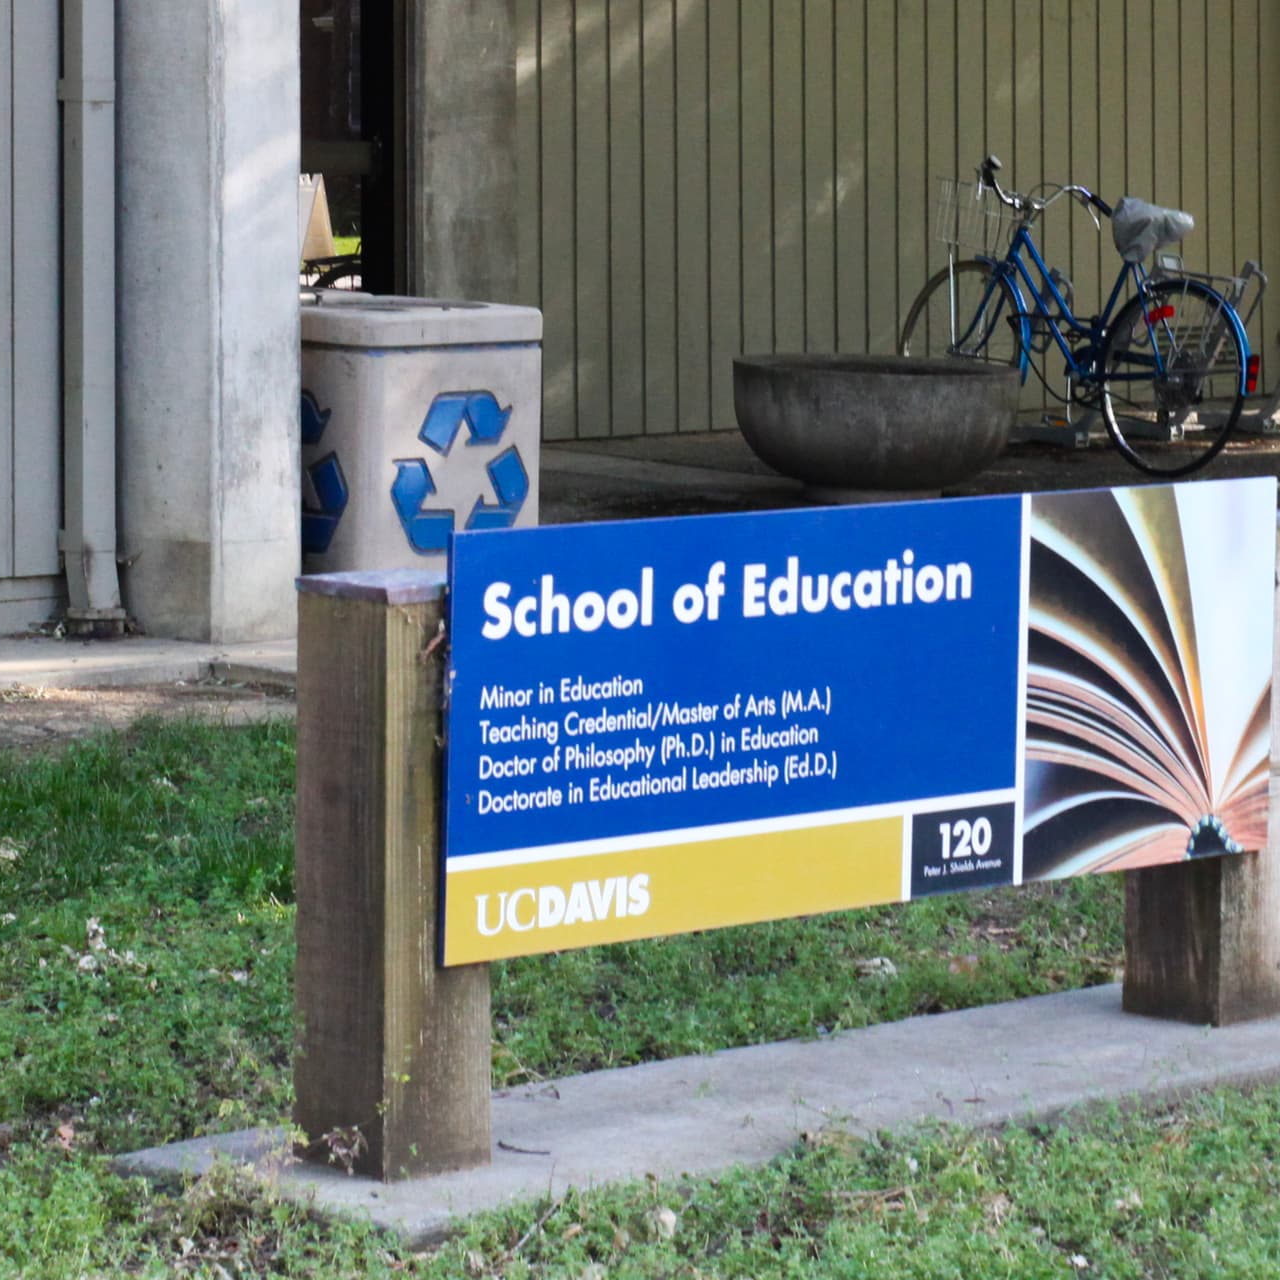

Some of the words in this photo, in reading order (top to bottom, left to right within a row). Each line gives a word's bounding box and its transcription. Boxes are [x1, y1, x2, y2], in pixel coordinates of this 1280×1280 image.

[481, 566, 654, 641] School
[672, 560, 726, 624] of
[742, 548, 972, 618] Education
[479, 684, 533, 710] Minor
[538, 682, 555, 705] in
[560, 675, 643, 703] Education
[479, 714, 559, 745] Teaching
[564, 701, 719, 736] Credential/Master
[723, 693, 741, 720] of
[744, 694, 776, 718] Arts
[781, 685, 832, 720] (M.A.)
[479, 755, 537, 780] Doctor
[541, 746, 561, 773] of
[565, 737, 656, 771] Philosophy
[660, 731, 716, 766] (Ph.D.)
[721, 731, 736, 754] in
[741, 724, 819, 752] Education
[478, 786, 563, 815] Doctorate
[568, 782, 583, 804] in
[589, 766, 687, 802] Educational
[692, 758, 779, 788] Leadership
[784, 750, 838, 785] (Ed.D.)
[939, 816, 992, 860] 120
